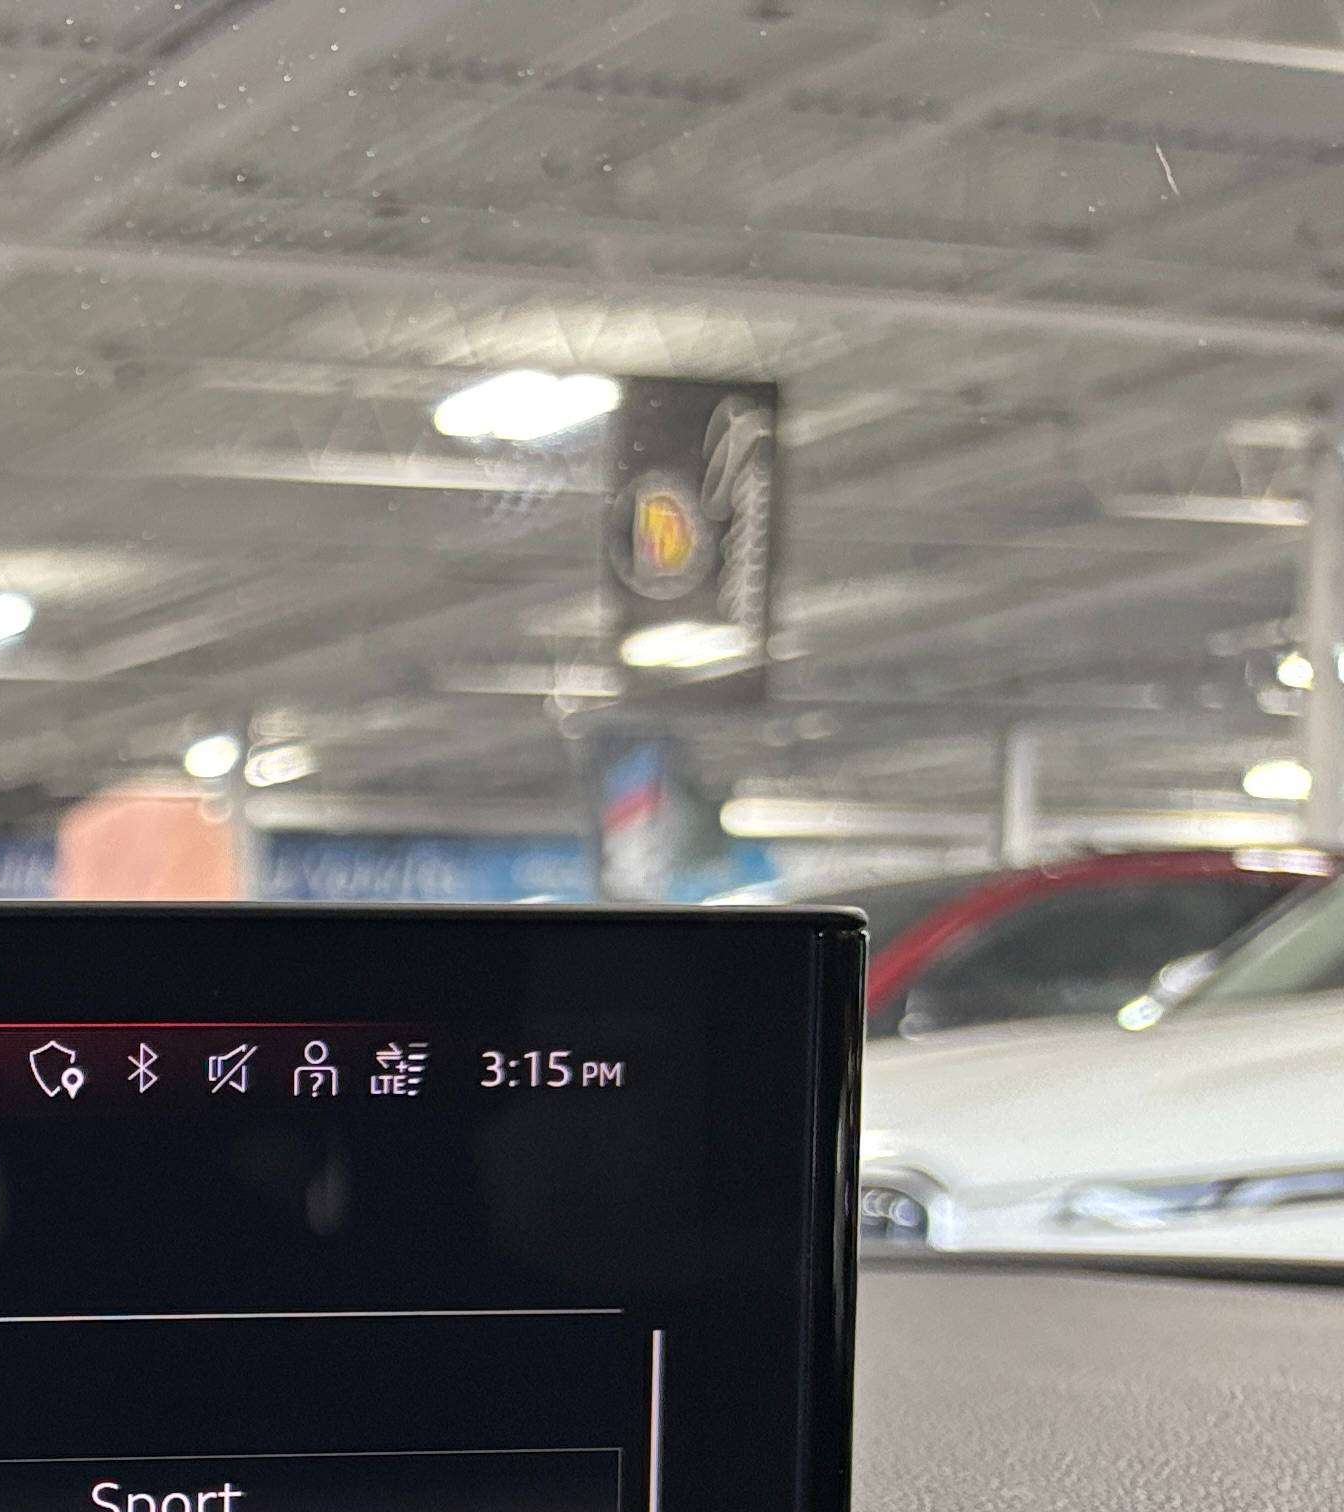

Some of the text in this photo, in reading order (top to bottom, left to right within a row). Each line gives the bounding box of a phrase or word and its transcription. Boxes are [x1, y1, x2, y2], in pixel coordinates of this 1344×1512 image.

[480, 1050, 624, 1088] 3:15 PM
[370, 1073, 407, 1096] LTE
